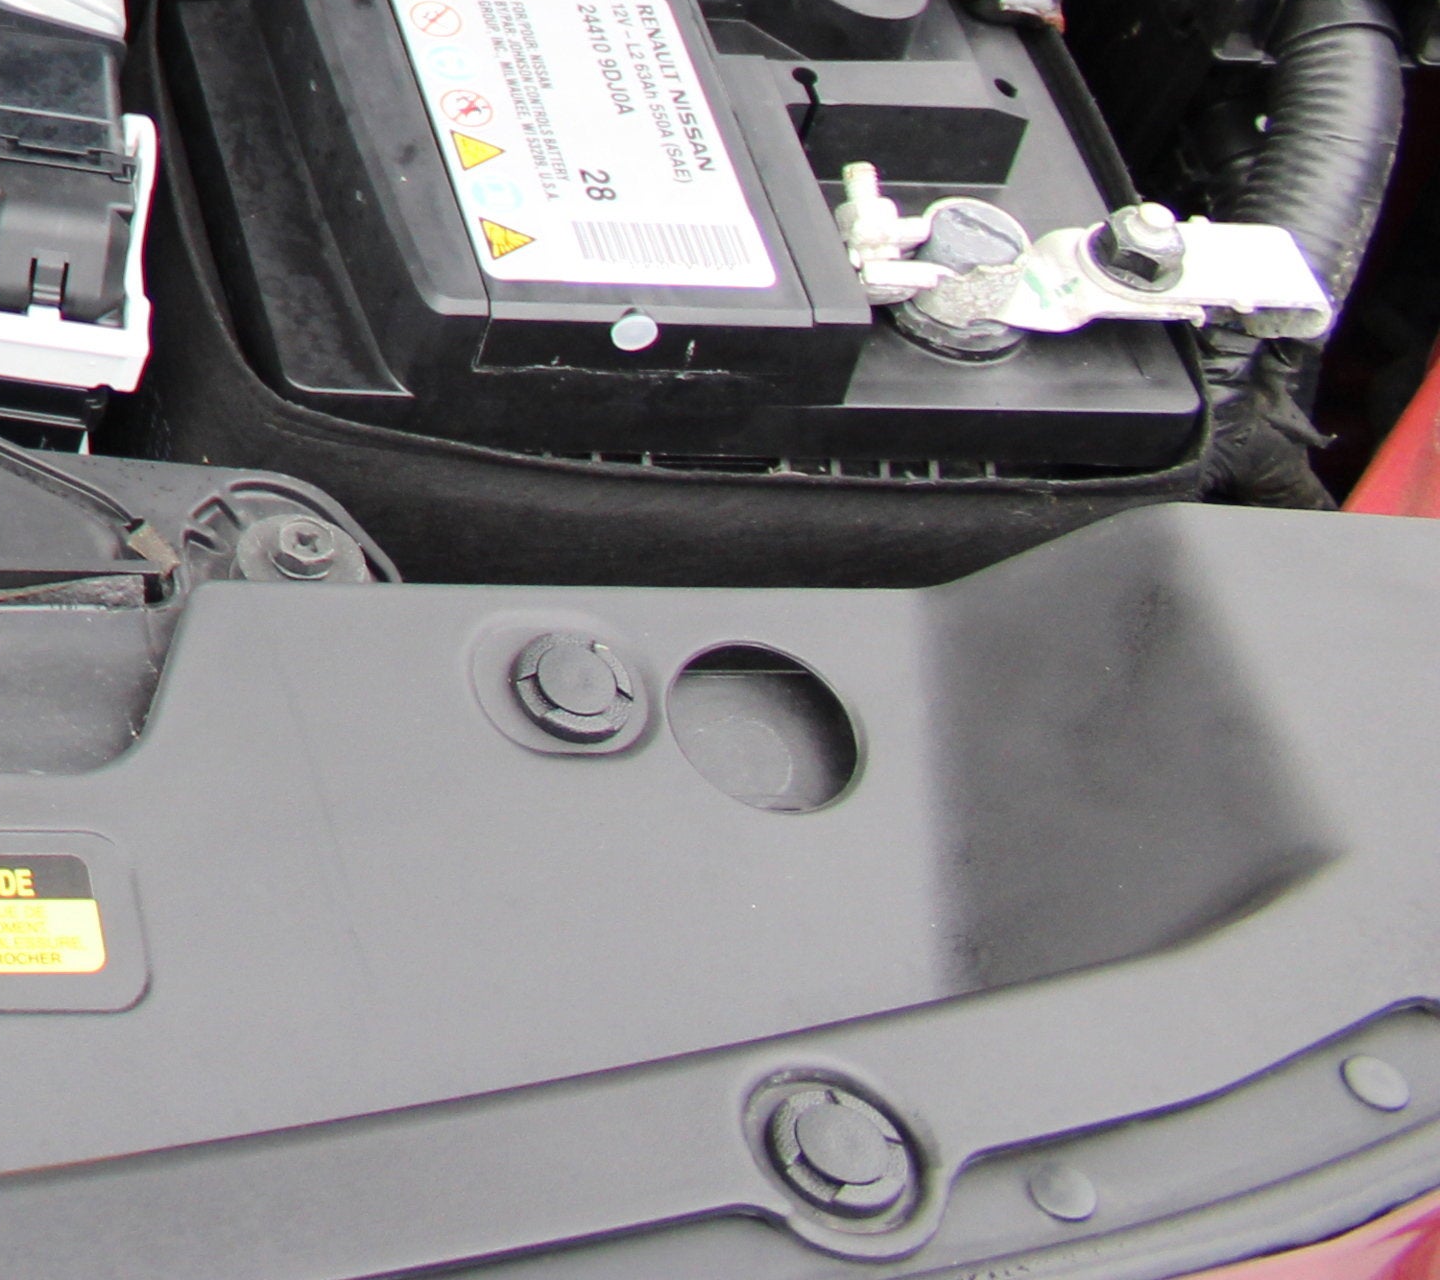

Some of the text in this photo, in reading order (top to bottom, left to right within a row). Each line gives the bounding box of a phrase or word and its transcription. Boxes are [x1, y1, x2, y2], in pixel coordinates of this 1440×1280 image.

[575, 3, 614, 53] 24410
[609, 3, 634, 26] 12V
[625, 42, 647, 60] L2
[527, 54, 554, 89] NISSAN
[632, 63, 662, 99] 63Ah
[634, 4, 716, 172] RENAULT NISSAN
[506, 38, 535, 83] JOHNSON
[523, 85, 554, 135] CONTROLS
[542, 137, 571, 181] BATTERY
[647, 103, 677, 138] 550A
[659, 142, 694, 184] (SAE)
[576, 168, 619, 202] 28
